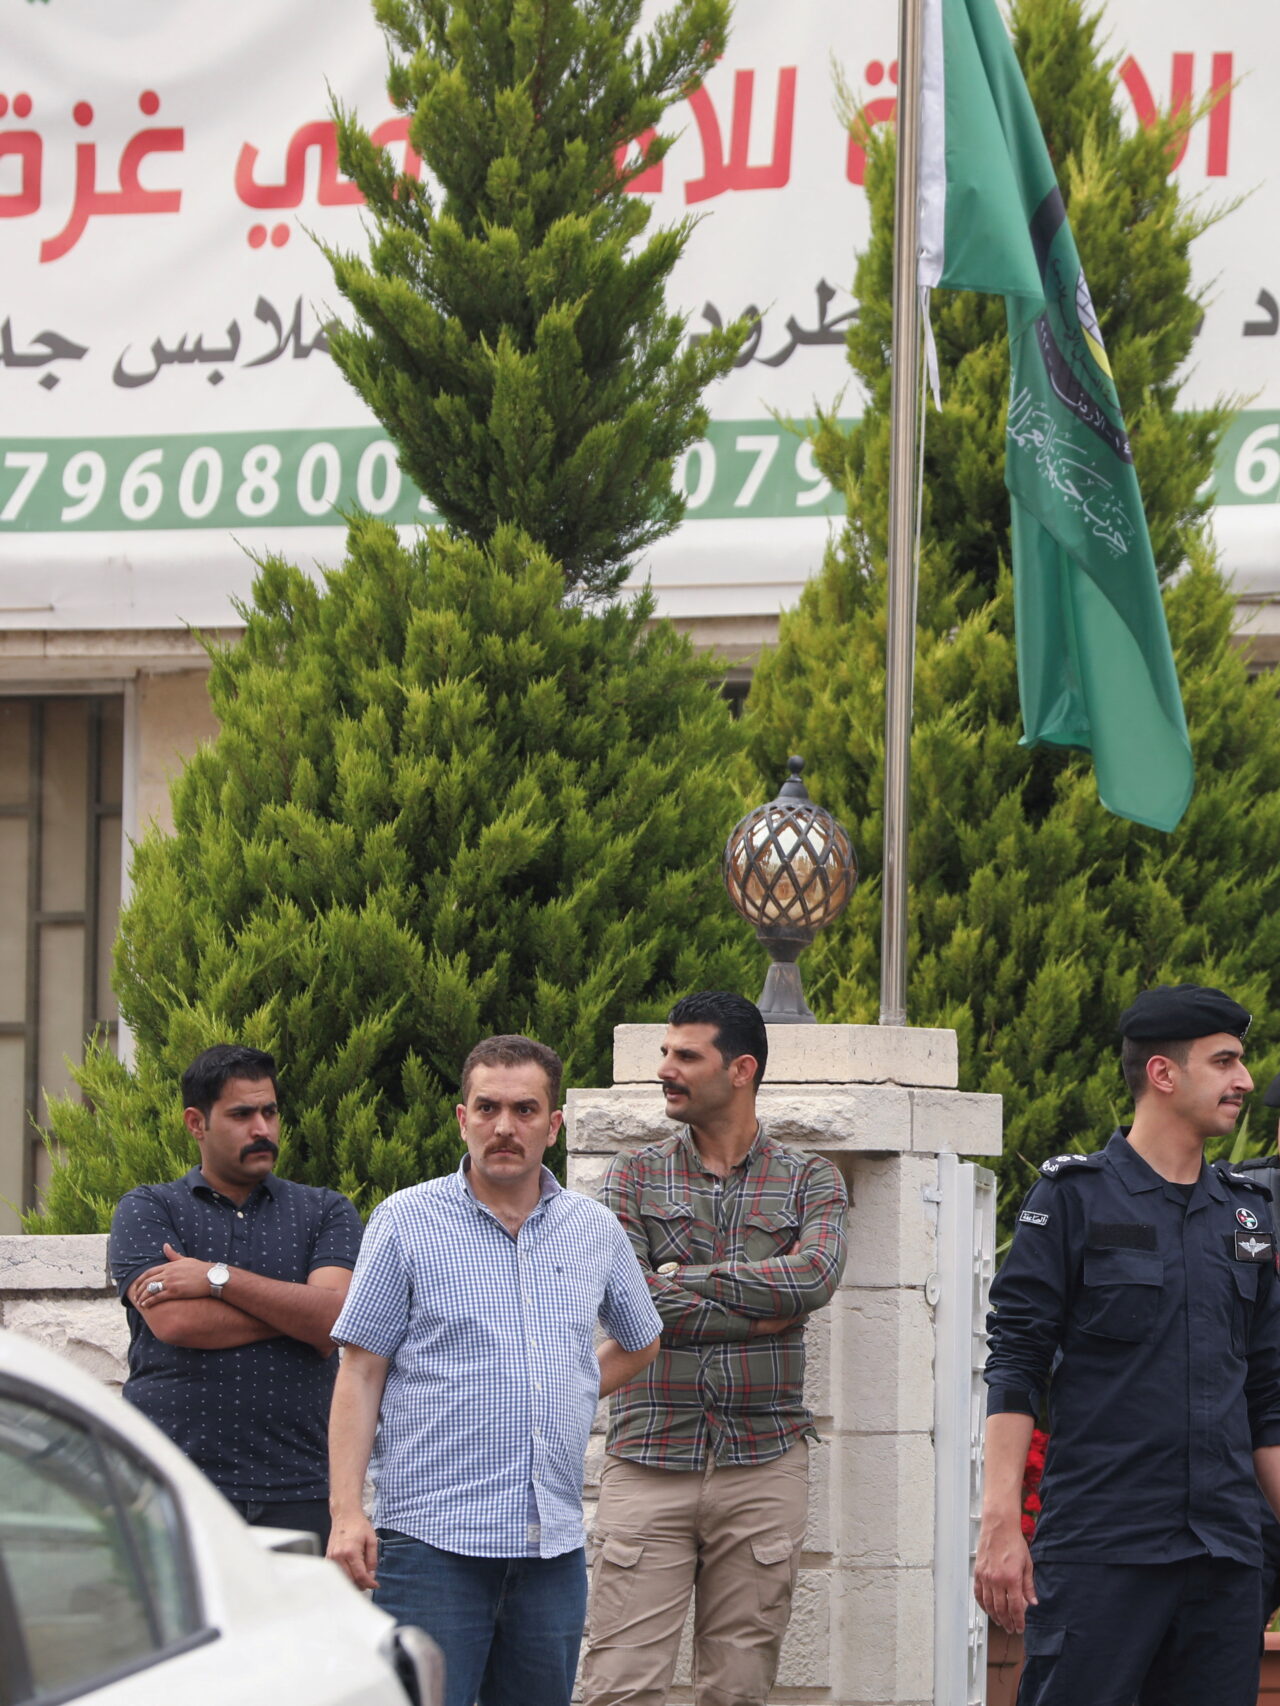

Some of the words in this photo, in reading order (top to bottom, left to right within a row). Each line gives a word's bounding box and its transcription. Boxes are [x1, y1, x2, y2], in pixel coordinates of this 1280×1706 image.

[0, 90, 185, 263] غزة
[112, 294, 340, 389] ملابس
[2, 440, 438, 523] 7960800
